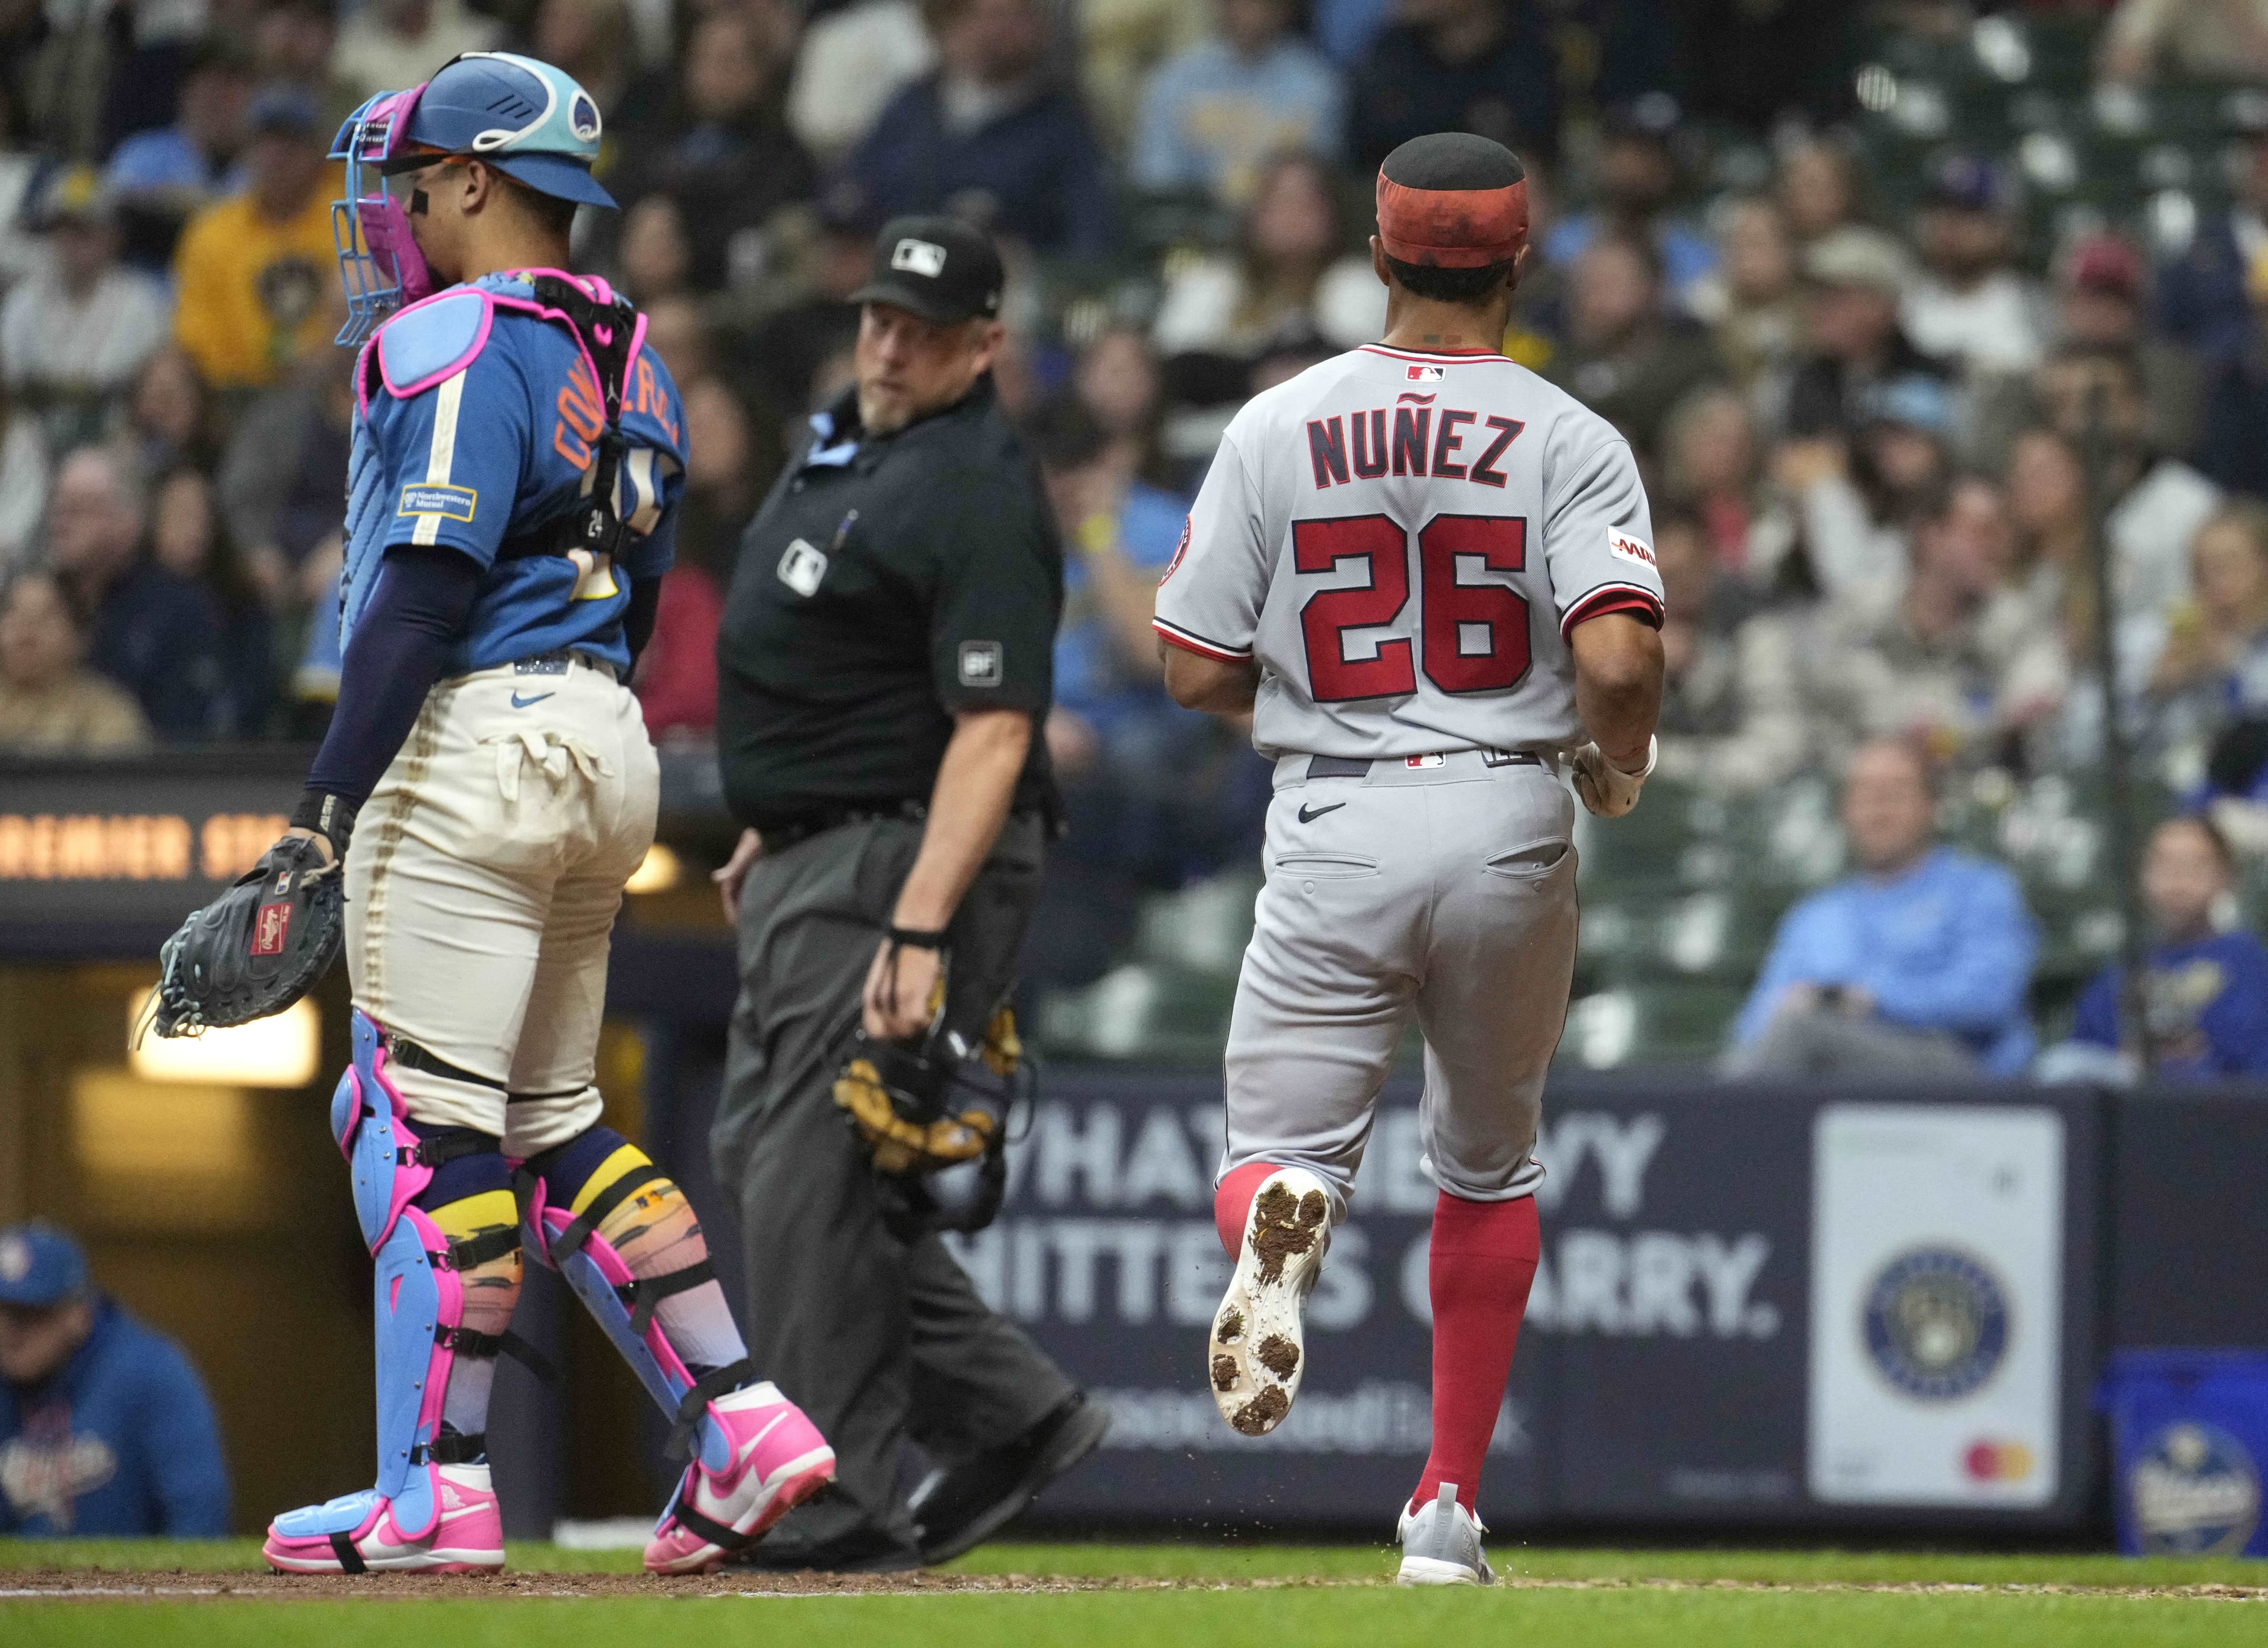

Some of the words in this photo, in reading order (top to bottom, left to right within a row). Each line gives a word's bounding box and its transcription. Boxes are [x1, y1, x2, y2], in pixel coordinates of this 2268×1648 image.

[1306, 393, 1526, 490] NUÑEZ
[416, 499, 444, 508] Mutual
[417, 491, 471, 506] Northwestern
[1292, 513, 1532, 703] 26
